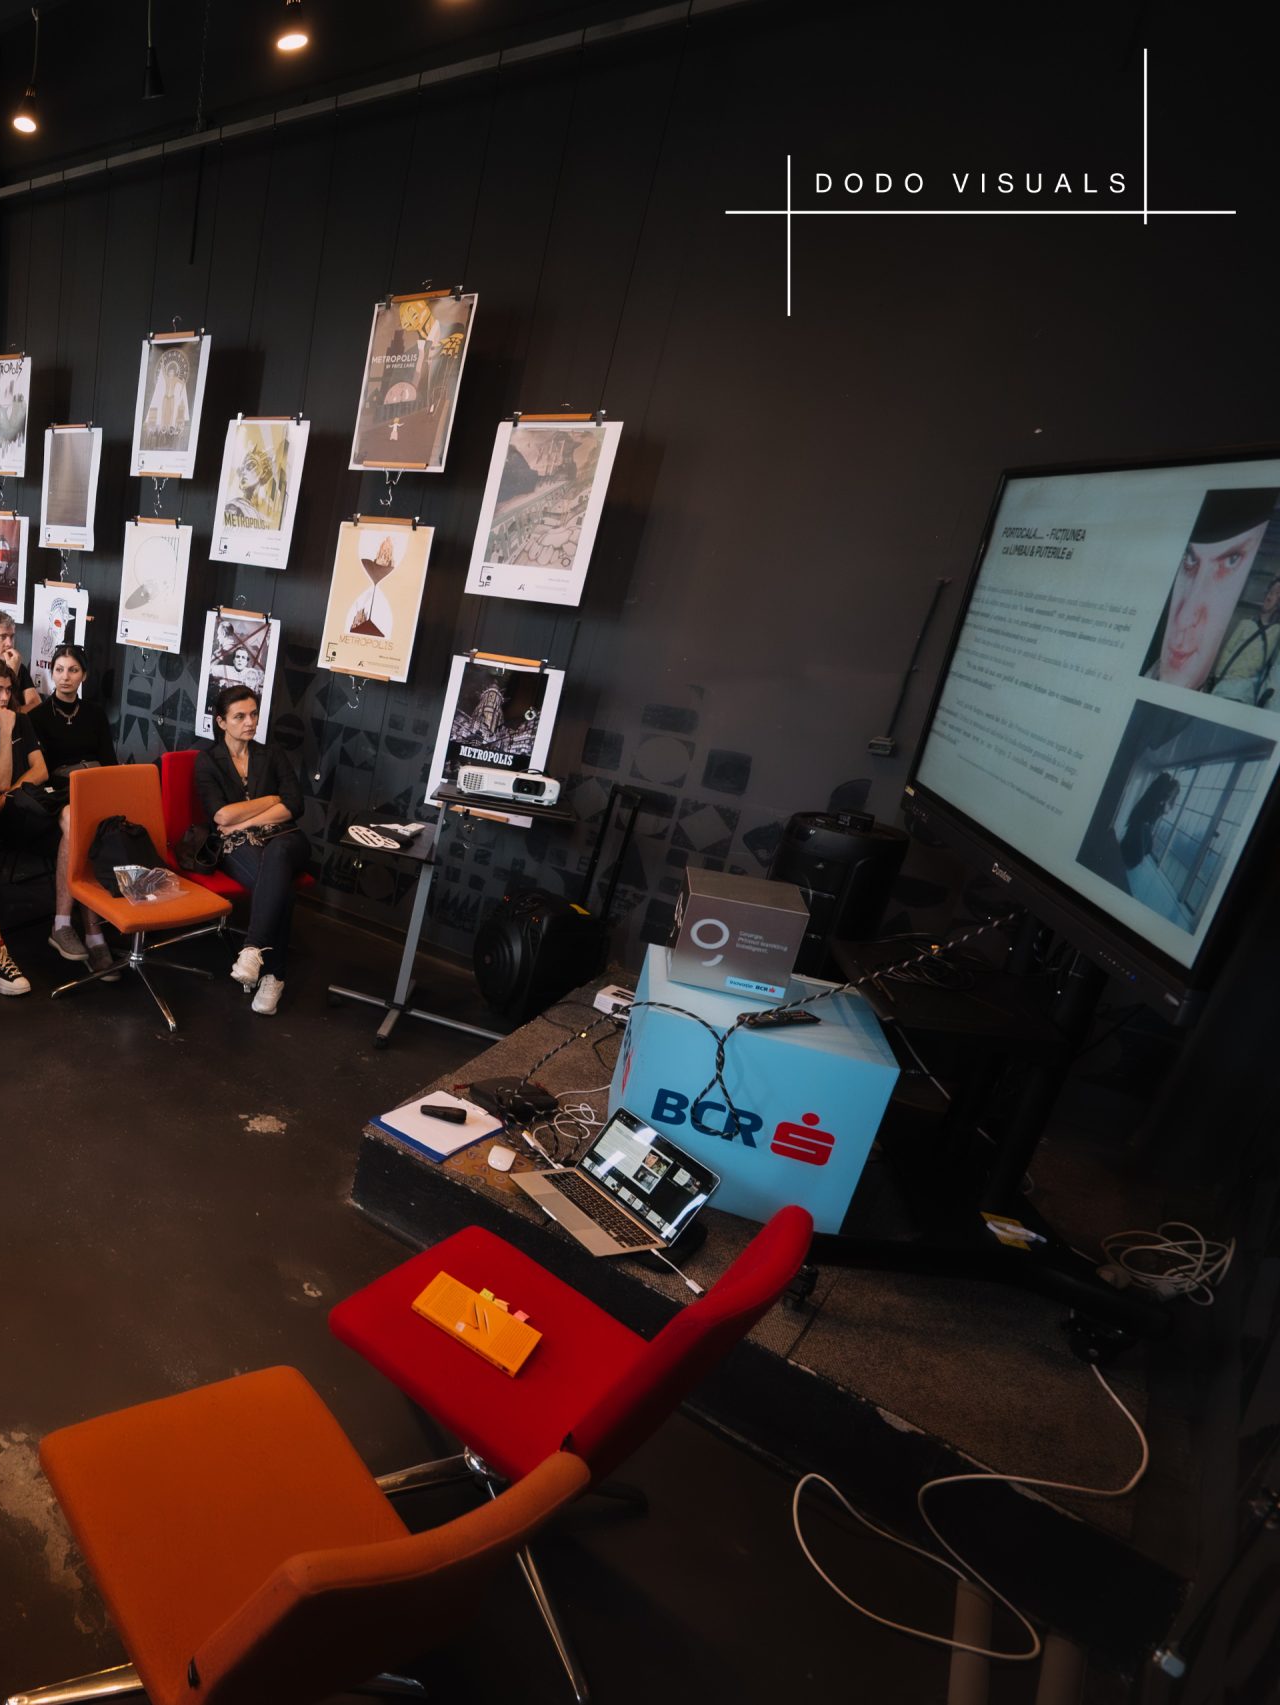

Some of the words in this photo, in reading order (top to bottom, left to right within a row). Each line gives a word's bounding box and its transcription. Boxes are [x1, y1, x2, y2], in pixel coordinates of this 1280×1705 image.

[372, 354, 418, 364] METROPOLIS
[224, 511, 266, 530] METROPOLIS
[459, 745, 514, 767] METROPOLIS
[754, 983, 769, 992] BCR
[650, 1087, 764, 1149] BCR
